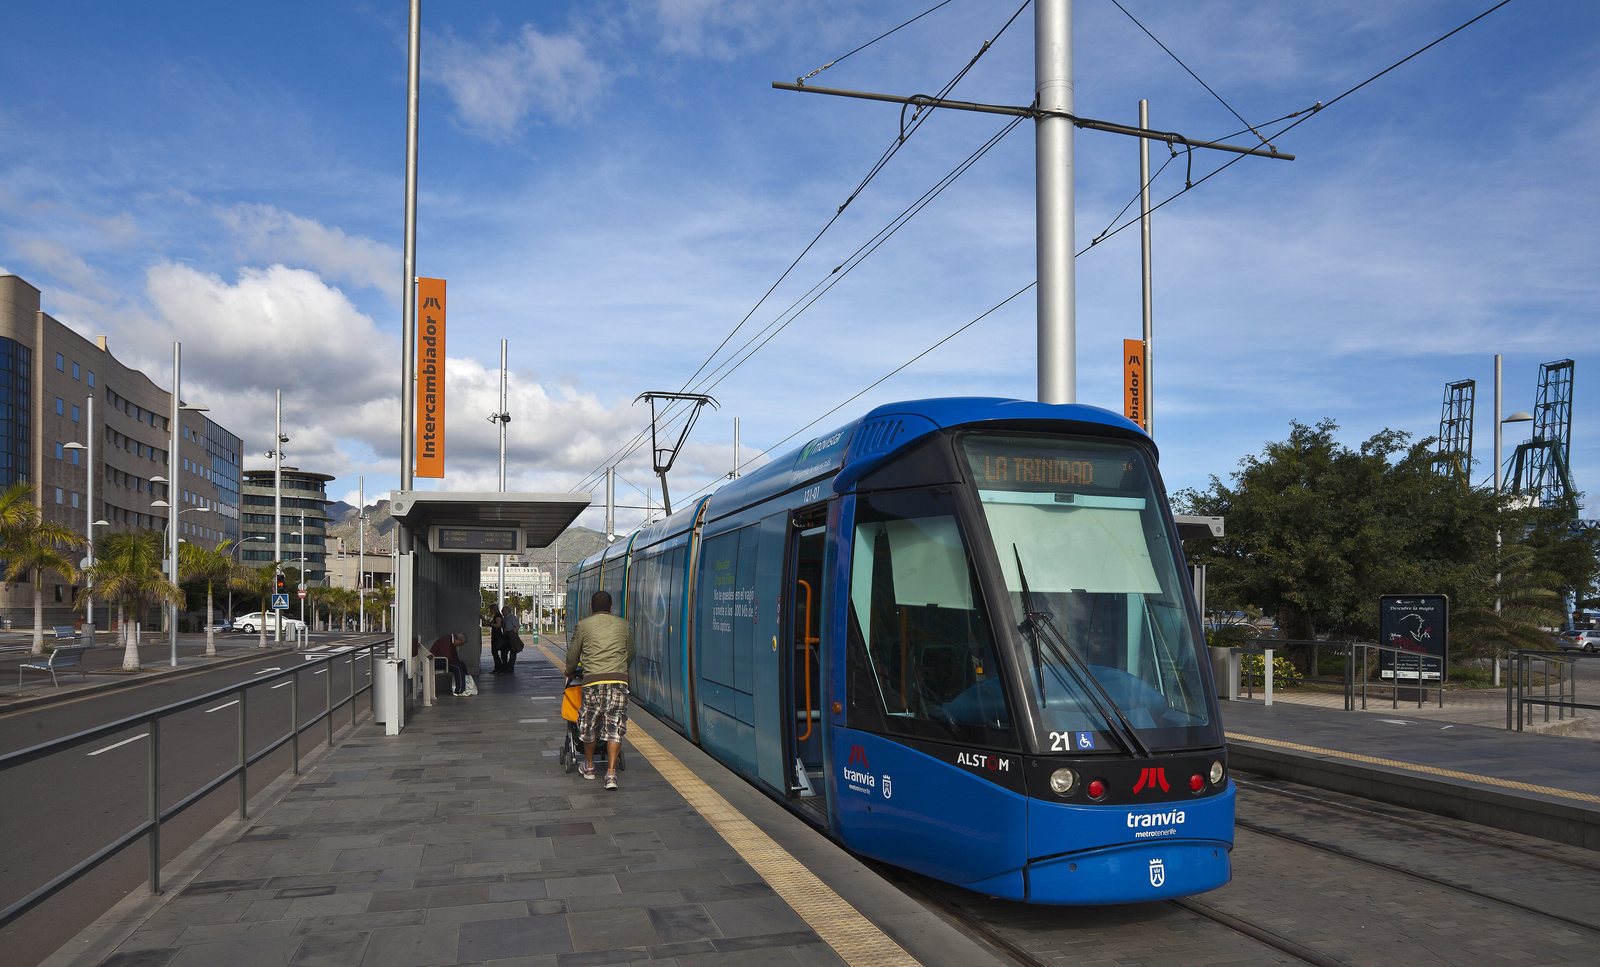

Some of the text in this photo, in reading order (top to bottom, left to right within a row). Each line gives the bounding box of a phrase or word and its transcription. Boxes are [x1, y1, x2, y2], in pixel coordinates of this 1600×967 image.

[422, 315, 437, 458] Intercambiador
[984, 455, 1094, 485] LA TRINIDAD
[1048, 731, 1071, 752] 21
[957, 752, 1009, 772] ALSTOM
[1127, 808, 1186, 828] tranvía
[1135, 828, 1177, 838] metrotenerife
